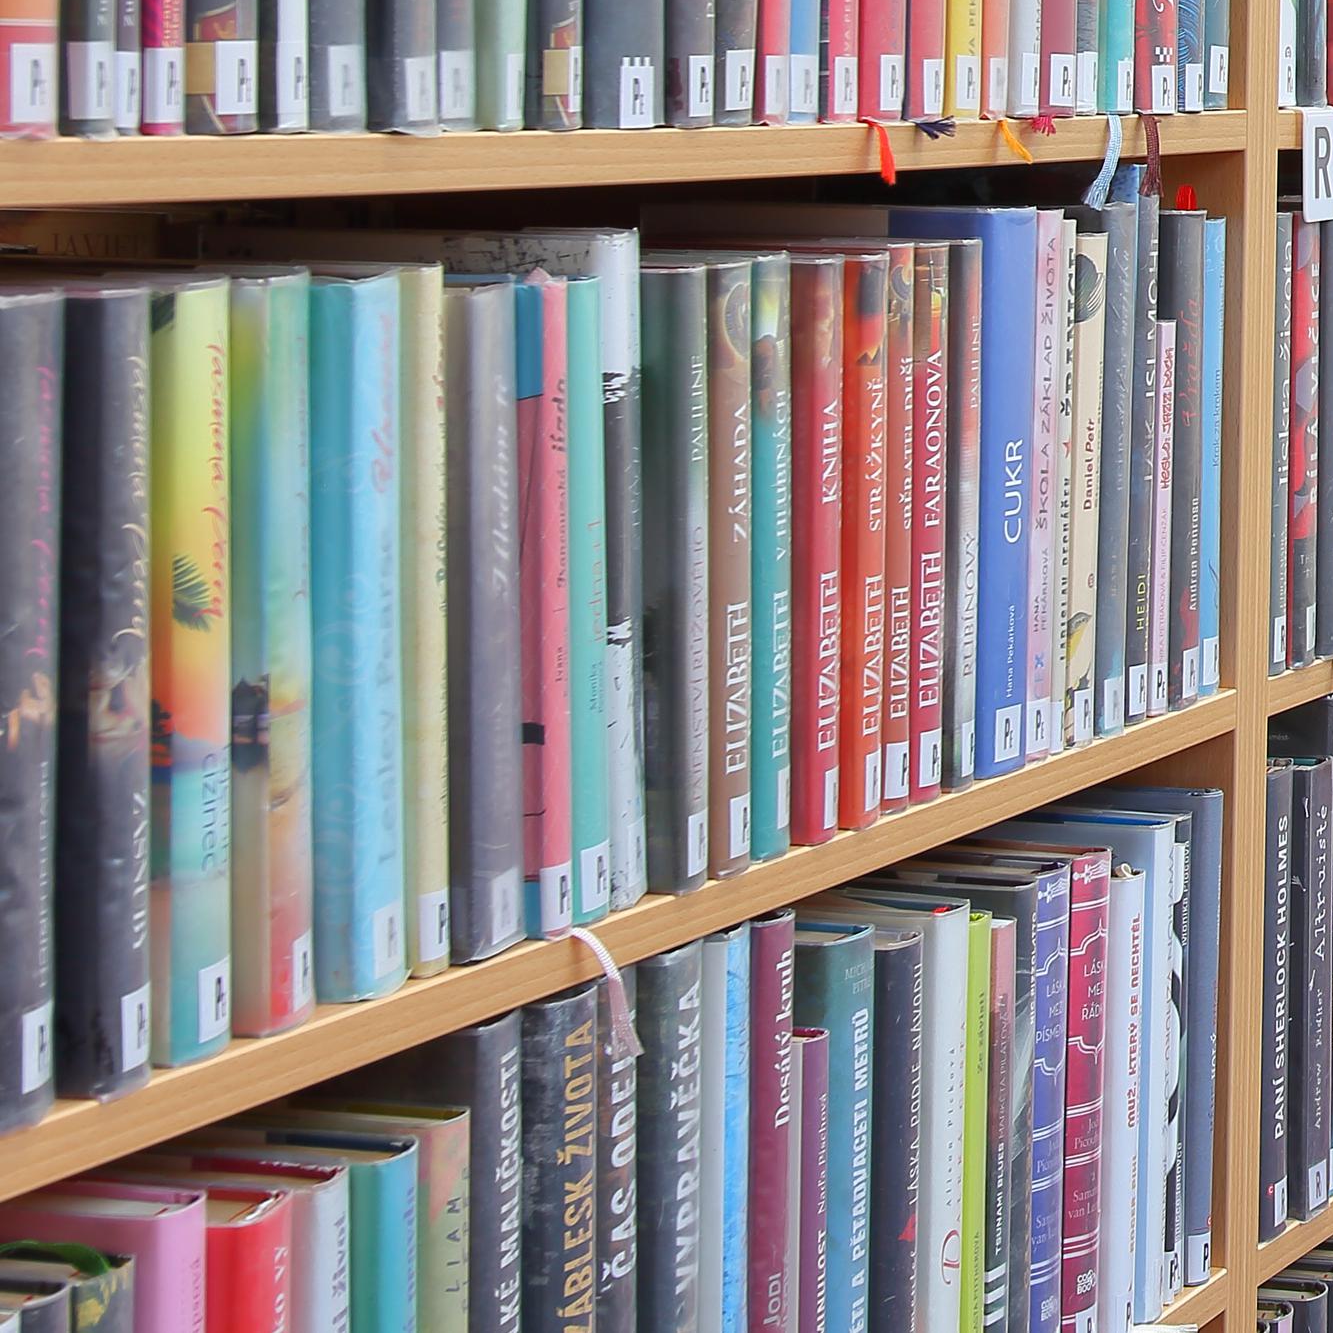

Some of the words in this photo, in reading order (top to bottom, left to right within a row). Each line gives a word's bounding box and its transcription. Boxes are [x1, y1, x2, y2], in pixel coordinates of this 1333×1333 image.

[1315, 127, 1333, 199] R
[925, 350, 943, 528] FARAONOVA
[1004, 438, 1024, 543] CUKR
[1083, 457, 1094, 510] Daniel
[726, 602, 749, 774] ELIZABETH
[818, 569, 838, 751] ELIZABETH
[863, 574, 882, 736] ELIZABETH
[890, 587, 909, 719] ELIZABETH
[919, 552, 942, 708] ELIZABETH
[1006, 667, 1015, 698] Hana
[1276, 816, 1289, 926] HOLMES
[1275, 931, 1287, 1067] SHERLOCK
[495, 1047, 521, 1269] MALIČKOSTI
[556, 1020, 592, 1165] ŽIVOTA
[670, 980, 700, 1292] VYPRAVĚČKA
[1273, 1076, 1285, 1139] PANÍ
[603, 1180, 637, 1278] ČAS
